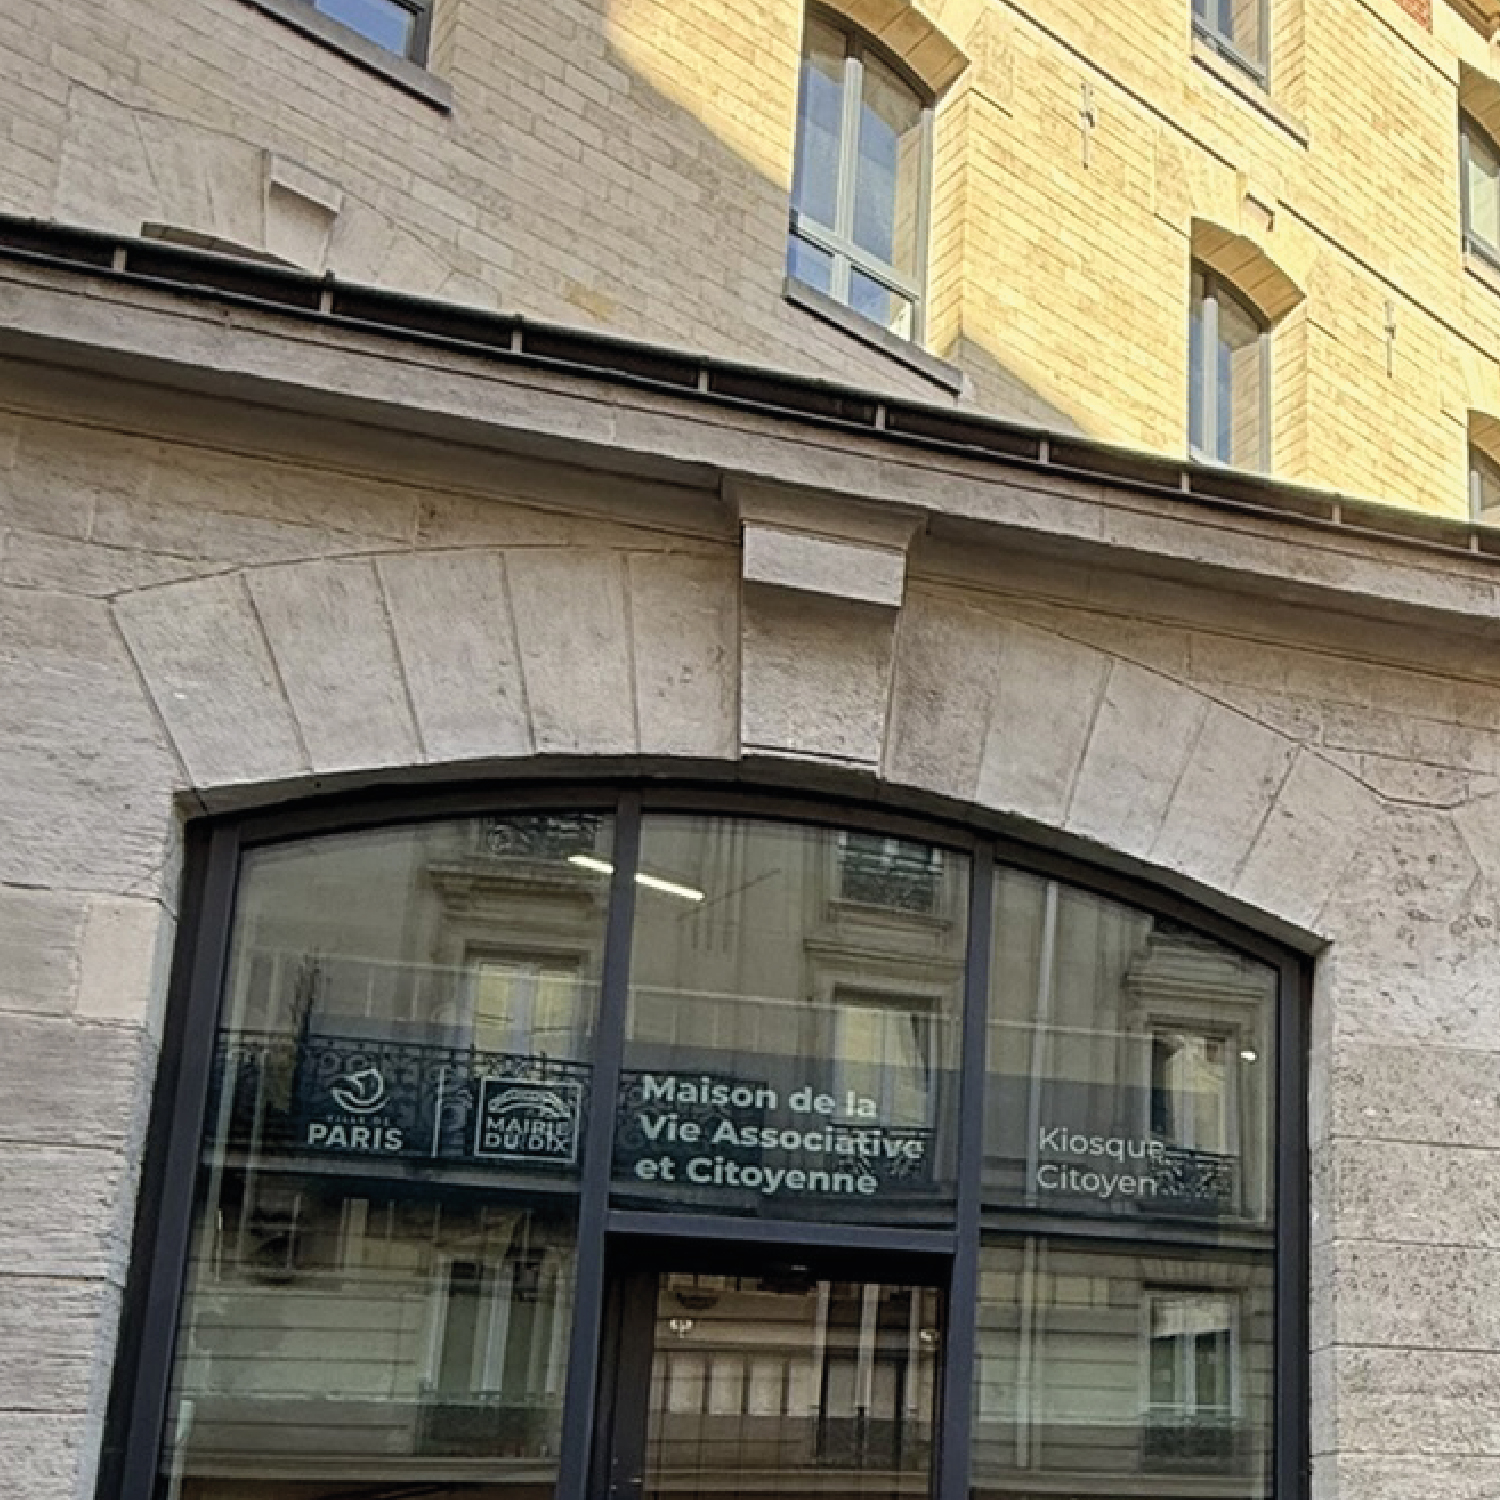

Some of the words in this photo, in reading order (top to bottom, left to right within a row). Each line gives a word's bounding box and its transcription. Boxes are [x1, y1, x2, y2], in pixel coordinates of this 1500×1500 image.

[642, 1075, 778, 1109] Maison
[789, 1086, 836, 1114] de
[846, 1090, 877, 1117] la
[307, 1123, 403, 1150] PARIS
[485, 1132, 520, 1150] DU
[487, 1116, 570, 1136] MAIRIE
[639, 1113, 701, 1142] Vie
[712, 1119, 925, 1159] Associative
[1039, 1126, 1165, 1164] Kiosque
[634, 1155, 676, 1181] et
[686, 1156, 878, 1195] Citoyenne
[1037, 1164, 1158, 1198] Citoyen
